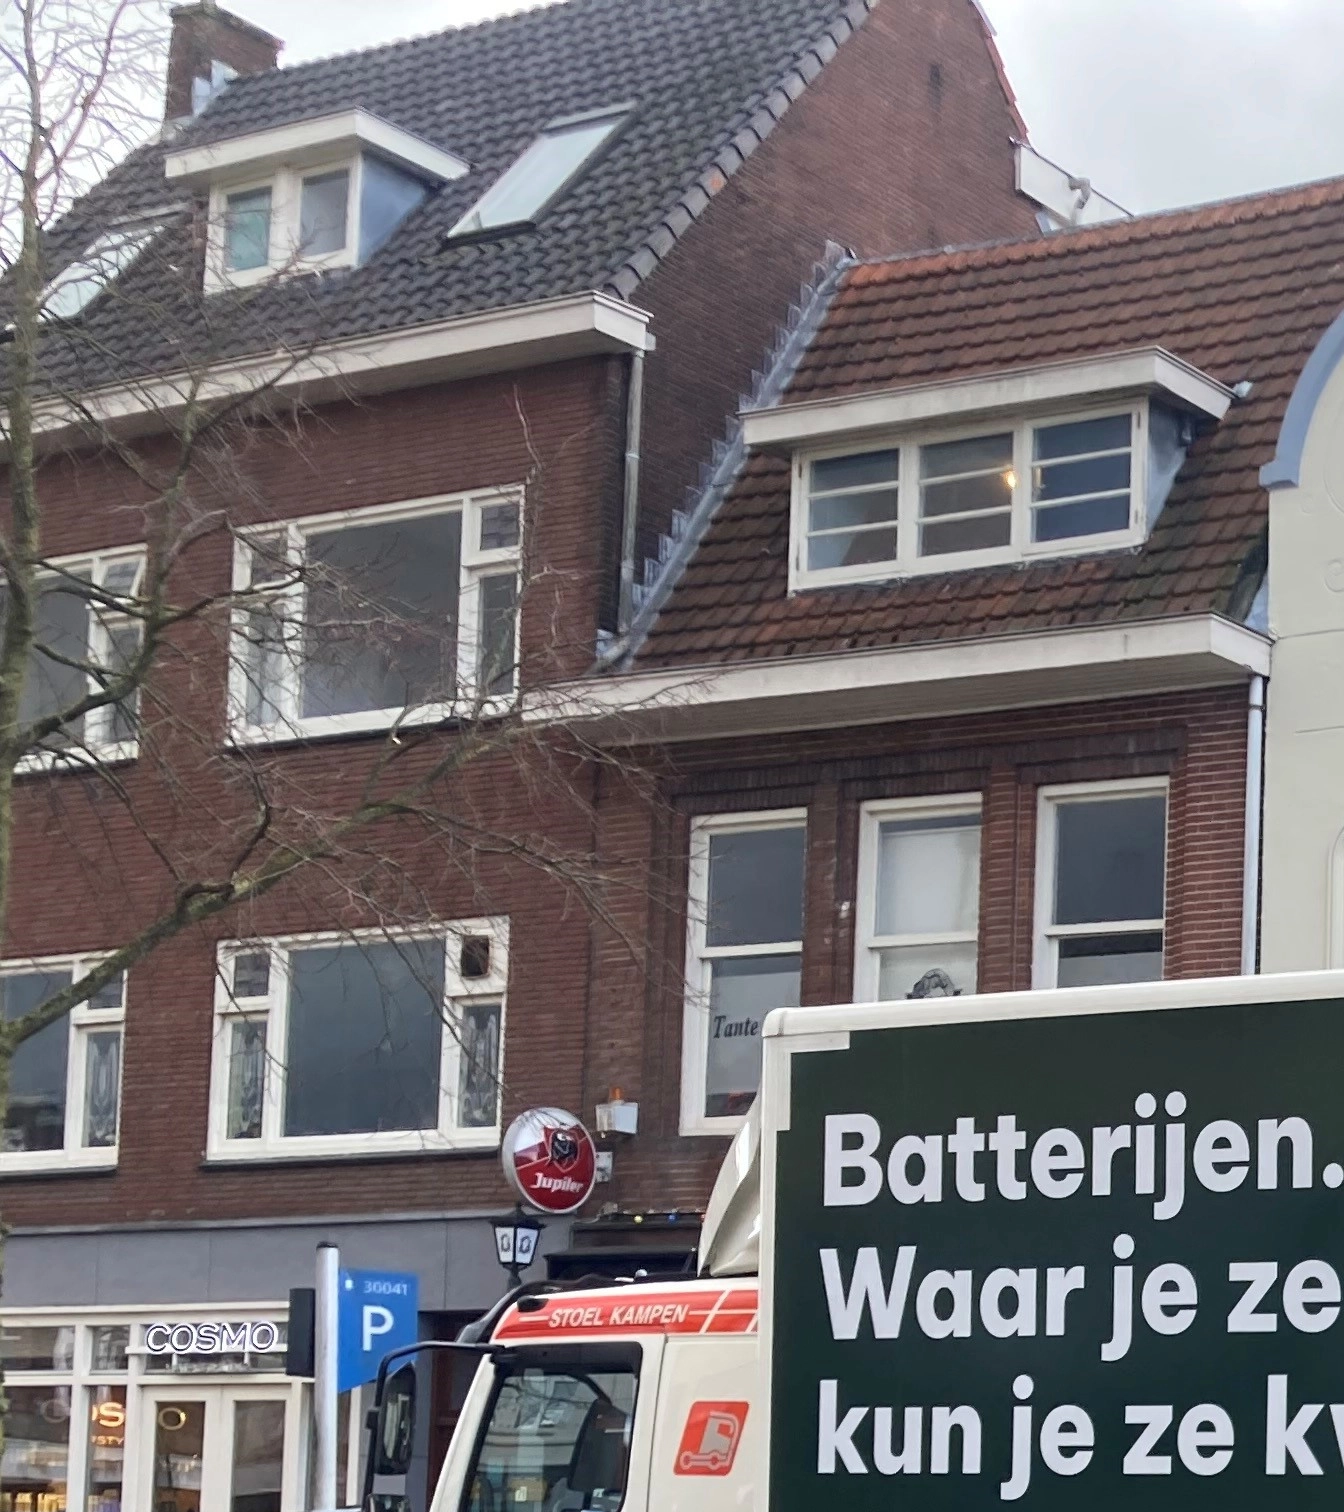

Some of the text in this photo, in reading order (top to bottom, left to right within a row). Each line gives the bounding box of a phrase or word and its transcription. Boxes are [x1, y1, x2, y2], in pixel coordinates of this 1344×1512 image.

[714, 1015, 758, 1038] Tante
[824, 1091, 1344, 1220] Batterijen.
[530, 1172, 584, 1193] Jupiler
[364, 1280, 408, 1296] 30041
[820, 1245, 1085, 1340] Waar
[1101, 1233, 1198, 1362] je
[1227, 1259, 1342, 1333] ze
[362, 1304, 394, 1352] P
[550, 1304, 690, 1328] STOEL KAMPEN
[145, 1320, 279, 1355] COSMO
[817, 1379, 982, 1475] kun
[1000, 1374, 1095, 1501] je
[1122, 1403, 1235, 1476] ze
